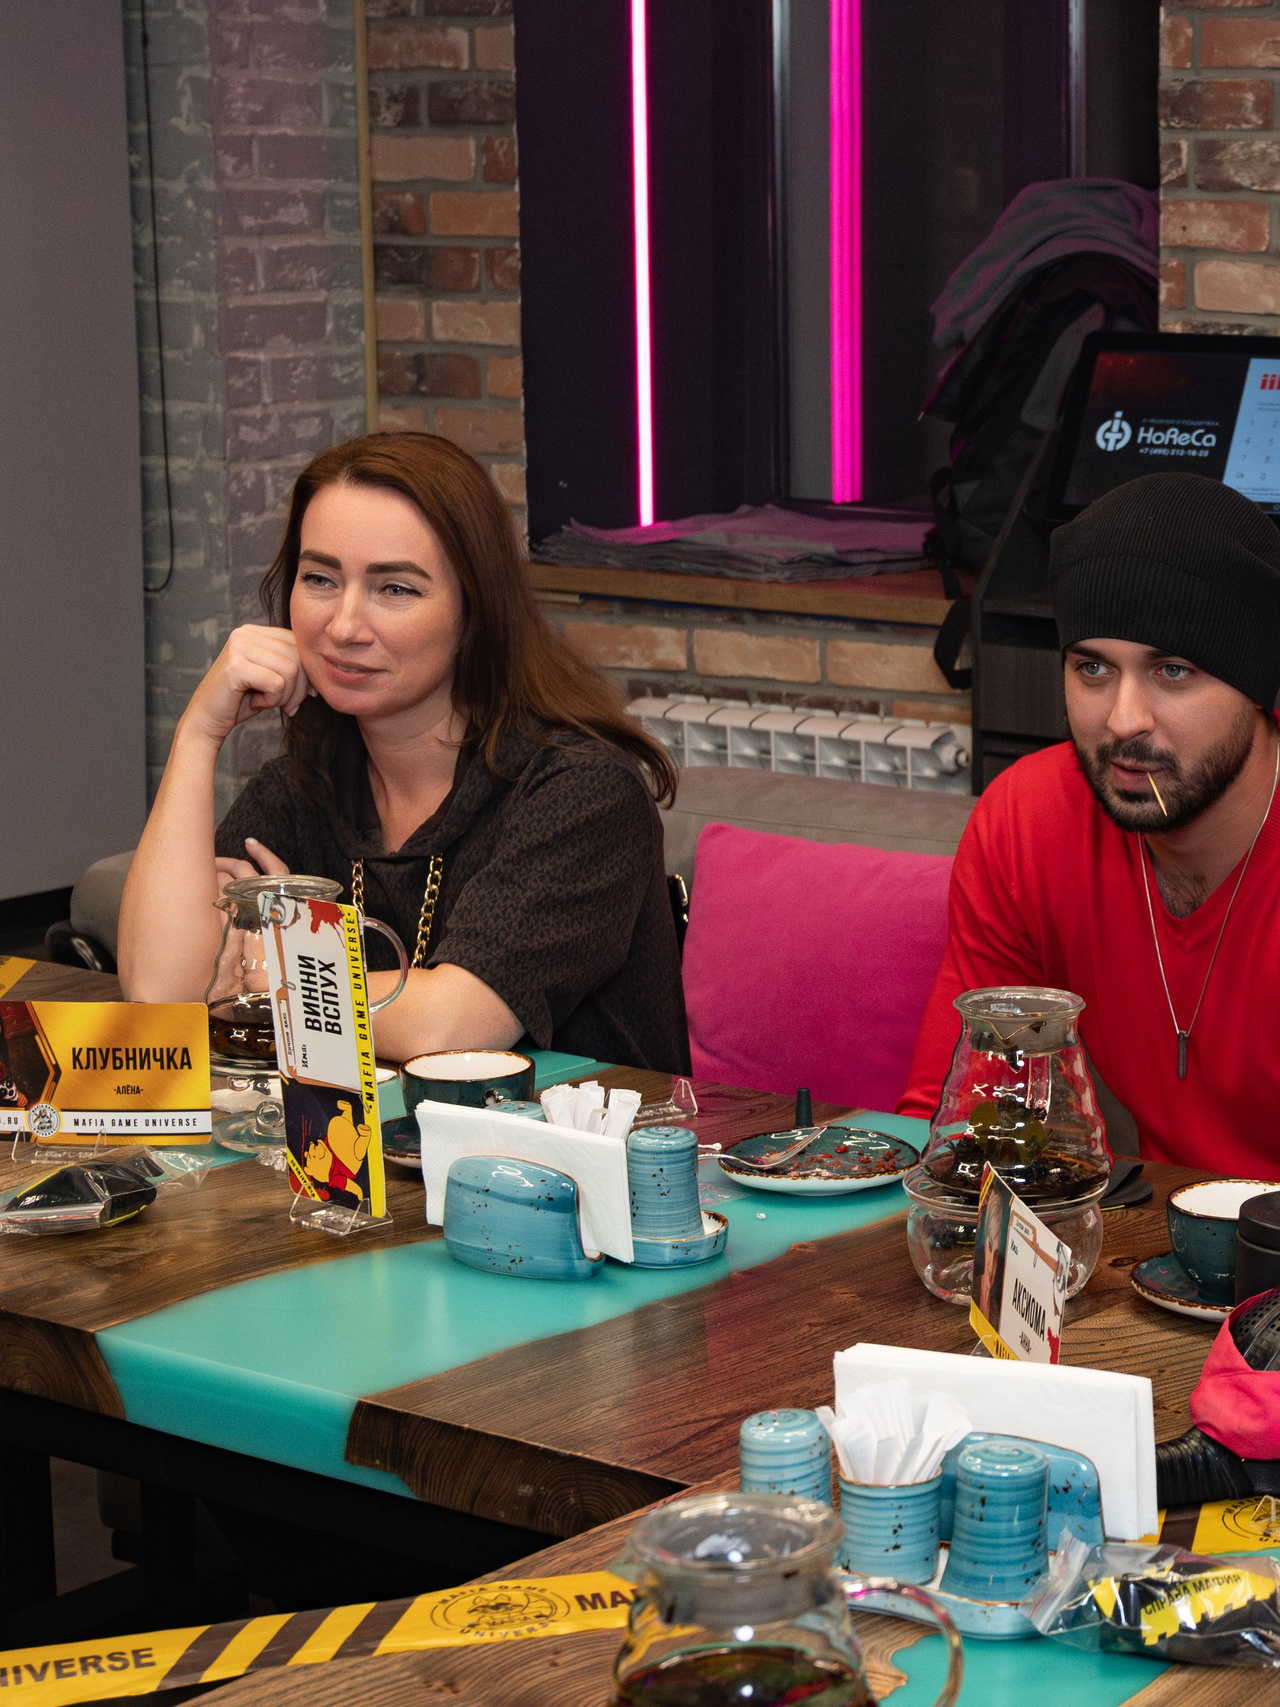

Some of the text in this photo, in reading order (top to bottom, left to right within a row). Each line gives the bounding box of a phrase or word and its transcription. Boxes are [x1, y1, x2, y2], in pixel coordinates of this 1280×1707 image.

[1136, 426, 1217, 447] HoReCa
[297, 954, 323, 1033] ВИННИ
[317, 960, 342, 1036] ВСПУХ
[347, 918, 375, 1102] MAFIA GAME UNIVERSE
[72, 1047, 192, 1070] КЛУБНИЧКА
[74, 1117, 198, 1127] MAFIA GAME UNIVERSE
[1011, 1277, 1046, 1342] АКСИОМА
